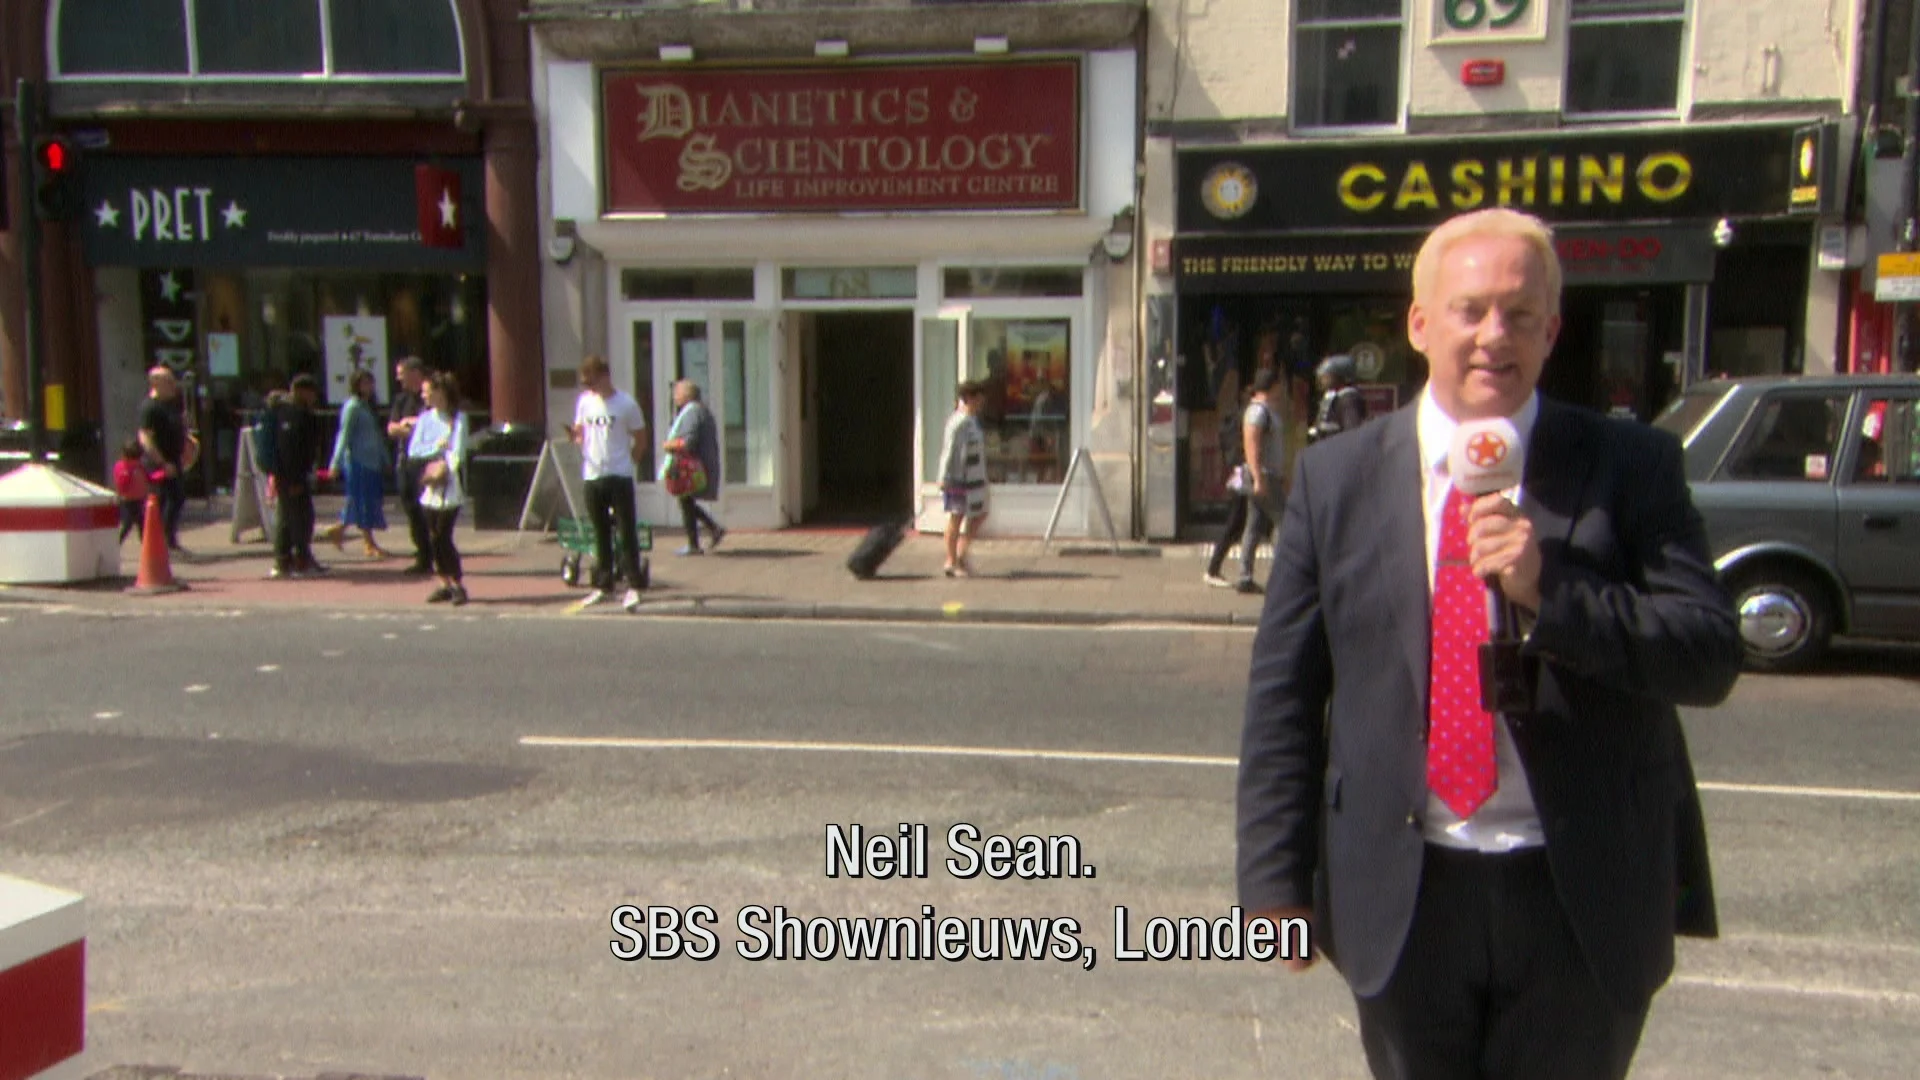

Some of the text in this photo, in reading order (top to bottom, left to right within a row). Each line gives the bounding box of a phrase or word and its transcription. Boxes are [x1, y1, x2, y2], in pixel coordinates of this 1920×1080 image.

[636, 83, 978, 142] DIANETICS &
[677, 132, 1043, 192] SCIENTOLOGY
[735, 174, 1059, 198] LIFE IMPROVEMENT CENTRE
[1337, 152, 1693, 213] CASHINO
[130, 187, 212, 241] PRET
[1183, 252, 1412, 274] THE FRIENDLY WAY TO W
